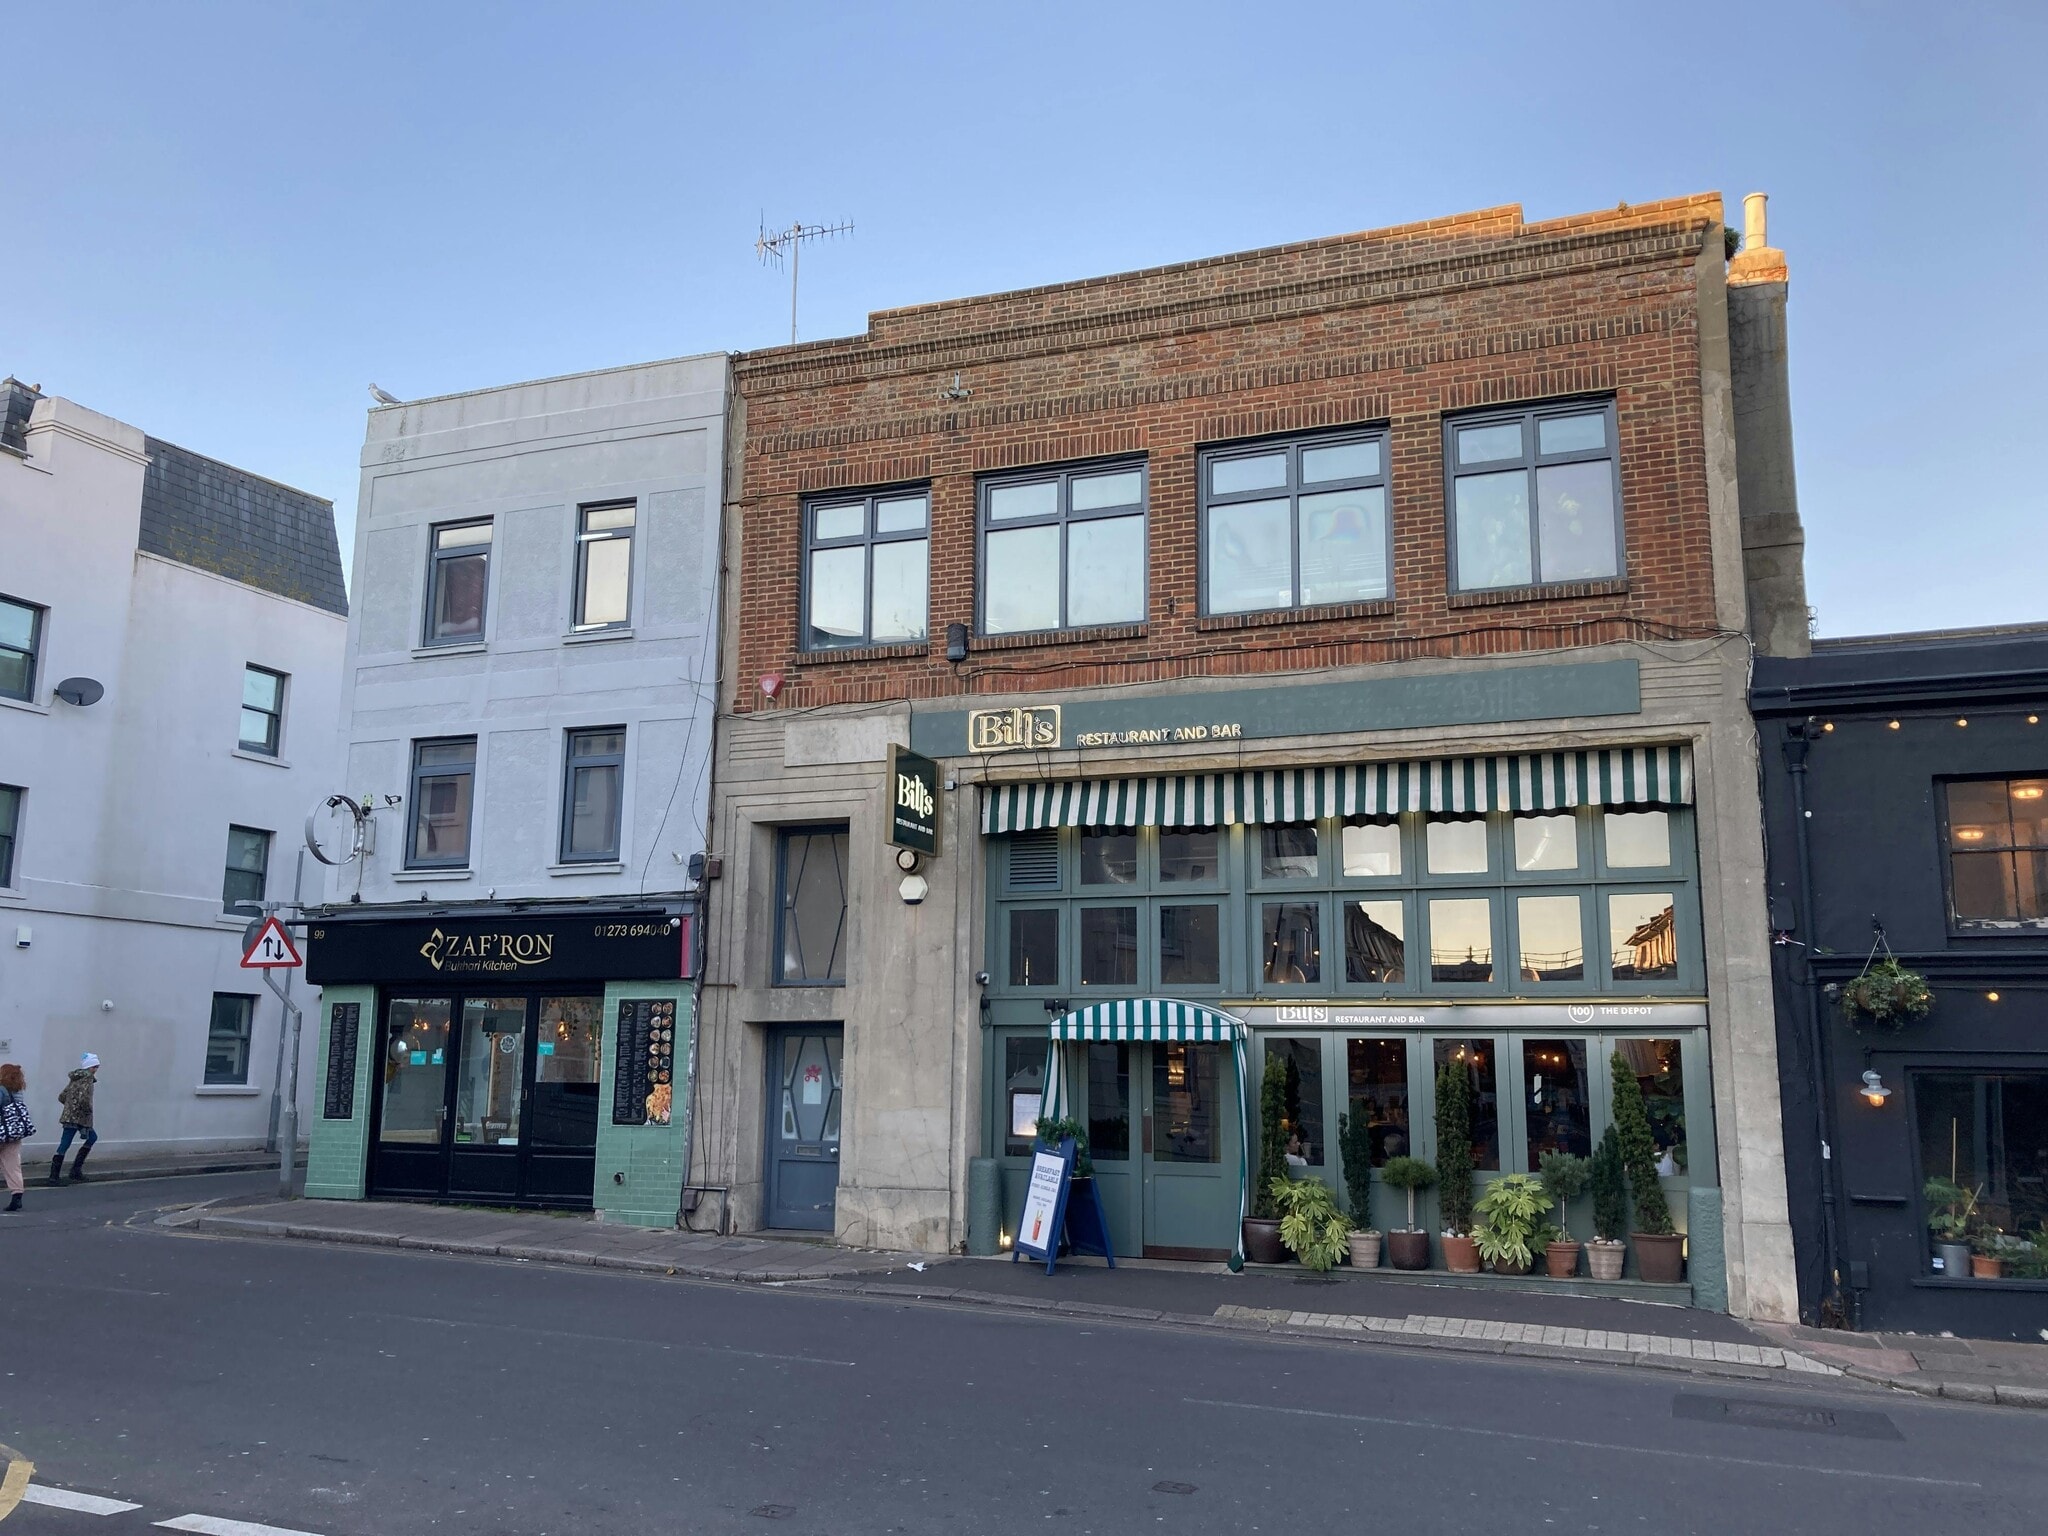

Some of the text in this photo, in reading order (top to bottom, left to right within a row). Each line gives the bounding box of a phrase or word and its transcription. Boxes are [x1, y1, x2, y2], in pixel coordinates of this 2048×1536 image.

[977, 707, 1055, 749] Bill's
[1076, 728, 1171, 747] RESTAURANT
[1174, 725, 1208, 741] AND
[1211, 723, 1242, 738] BAR
[897, 773, 933, 818] Bill's
[314, 929, 325, 940] 99
[594, 923, 671, 937] 01273 694040
[482, 960, 518, 972] Kitchen
[1571, 1006, 1591, 1016] 100
[1600, 1006, 1653, 1015] THE DEPOT
[1335, 1015, 1425, 1024] RESTAURANT AND BAR
